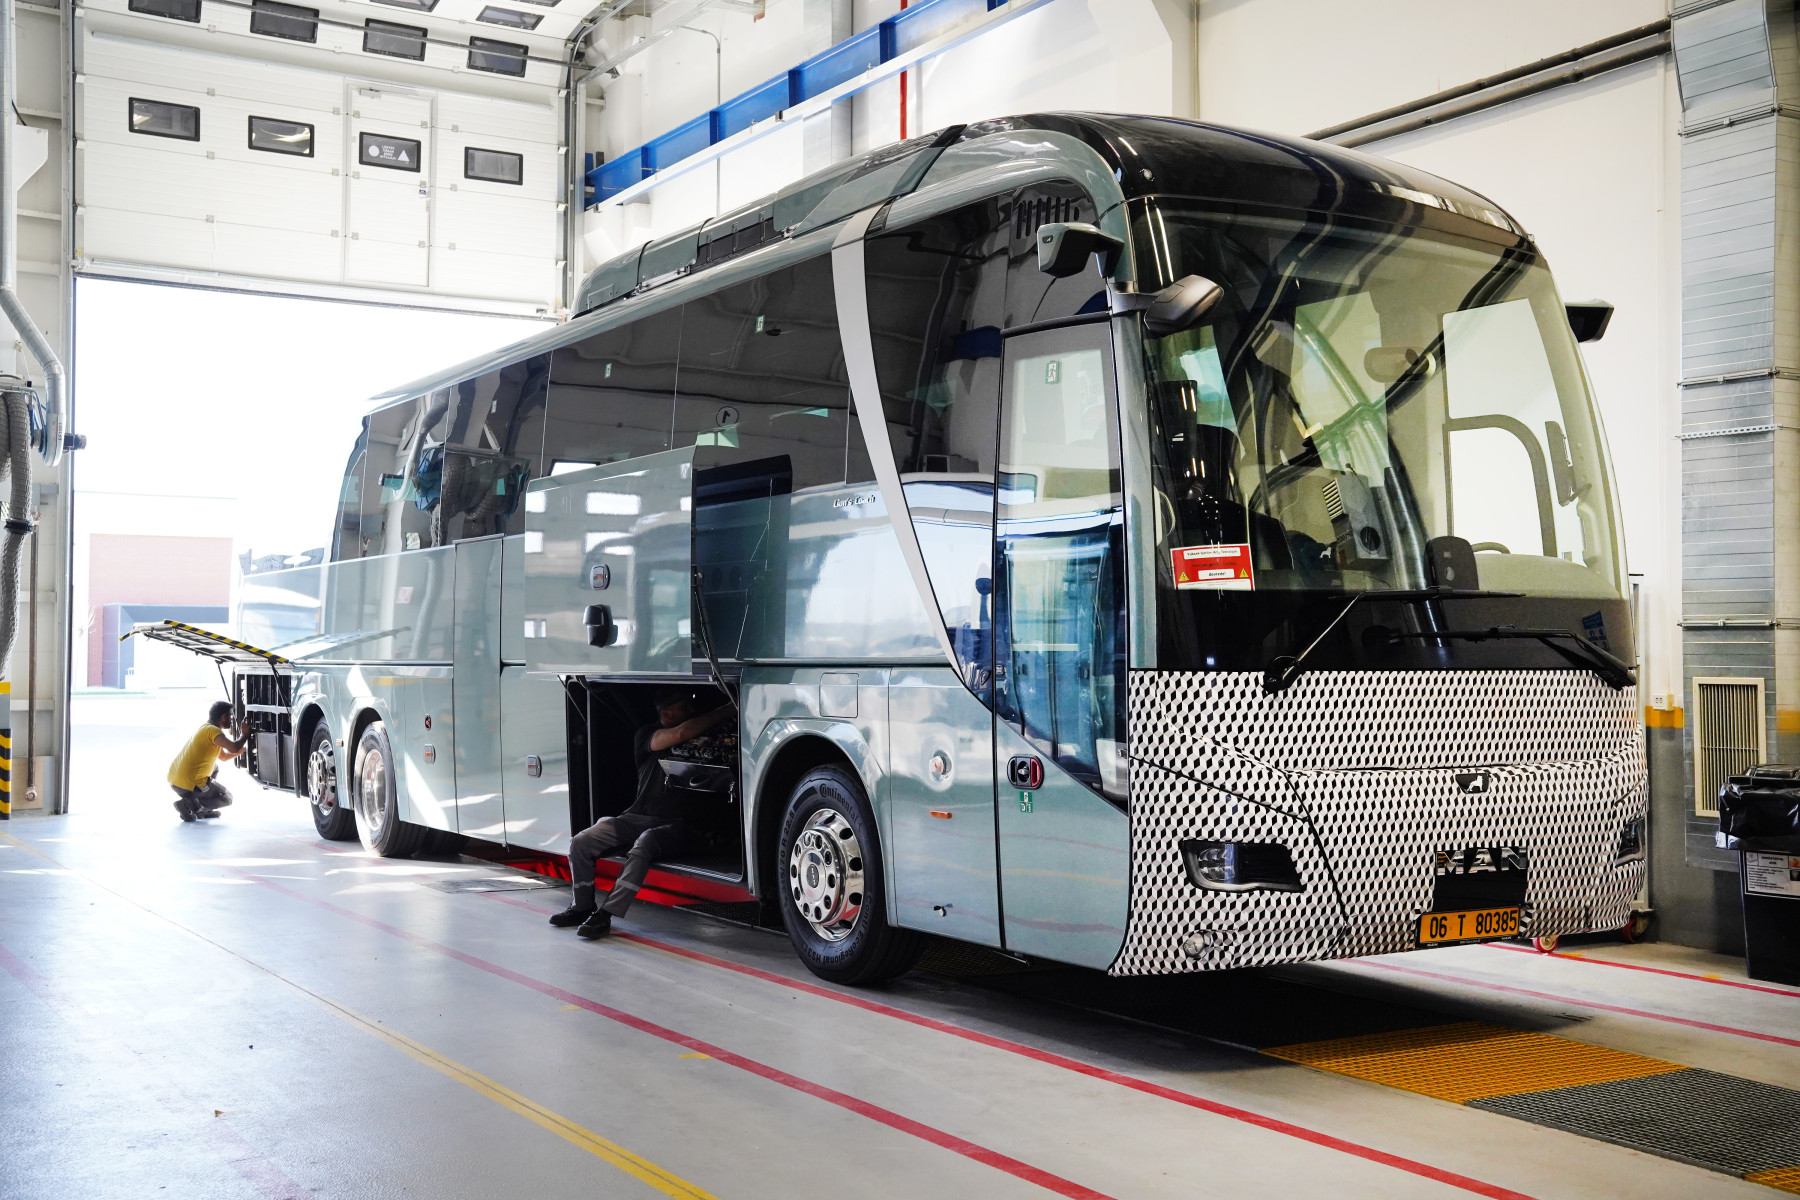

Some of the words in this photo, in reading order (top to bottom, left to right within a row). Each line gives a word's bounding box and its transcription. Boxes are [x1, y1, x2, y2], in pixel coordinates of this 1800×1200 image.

[820, 783, 859, 823] Continental
[1436, 846, 1527, 876] MAN
[1429, 915, 1448, 939] 06
[1457, 913, 1467, 937] T
[1475, 909, 1518, 935] 80385
[807, 948, 822, 963] HS3
[823, 930, 864, 965] EcoRegional
